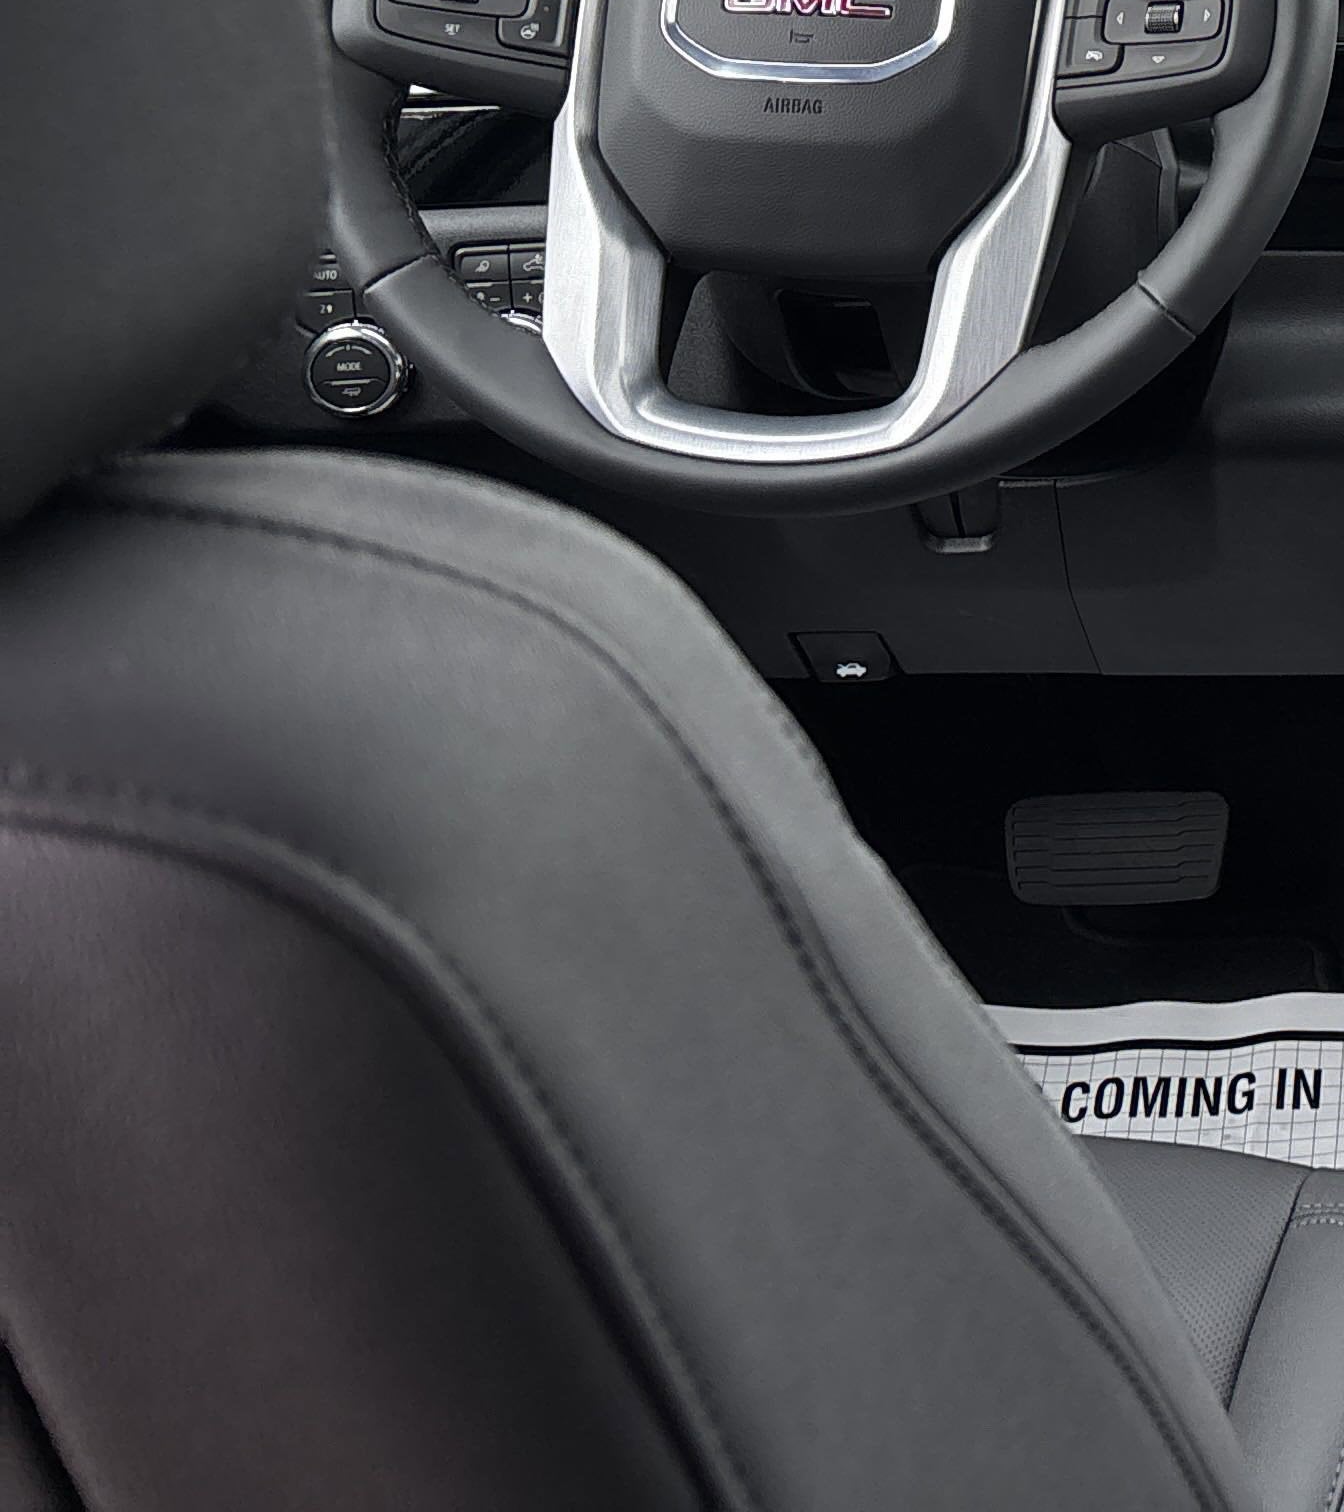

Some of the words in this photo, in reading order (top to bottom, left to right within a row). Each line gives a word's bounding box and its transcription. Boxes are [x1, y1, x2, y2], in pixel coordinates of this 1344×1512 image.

[444, 23, 461, 33] SET
[763, 96, 823, 115] AIRBAG
[313, 268, 338, 281] AUTO
[336, 361, 363, 372] MODE
[1060, 1071, 1257, 1124] COMING
[1275, 1067, 1323, 1110] IN
